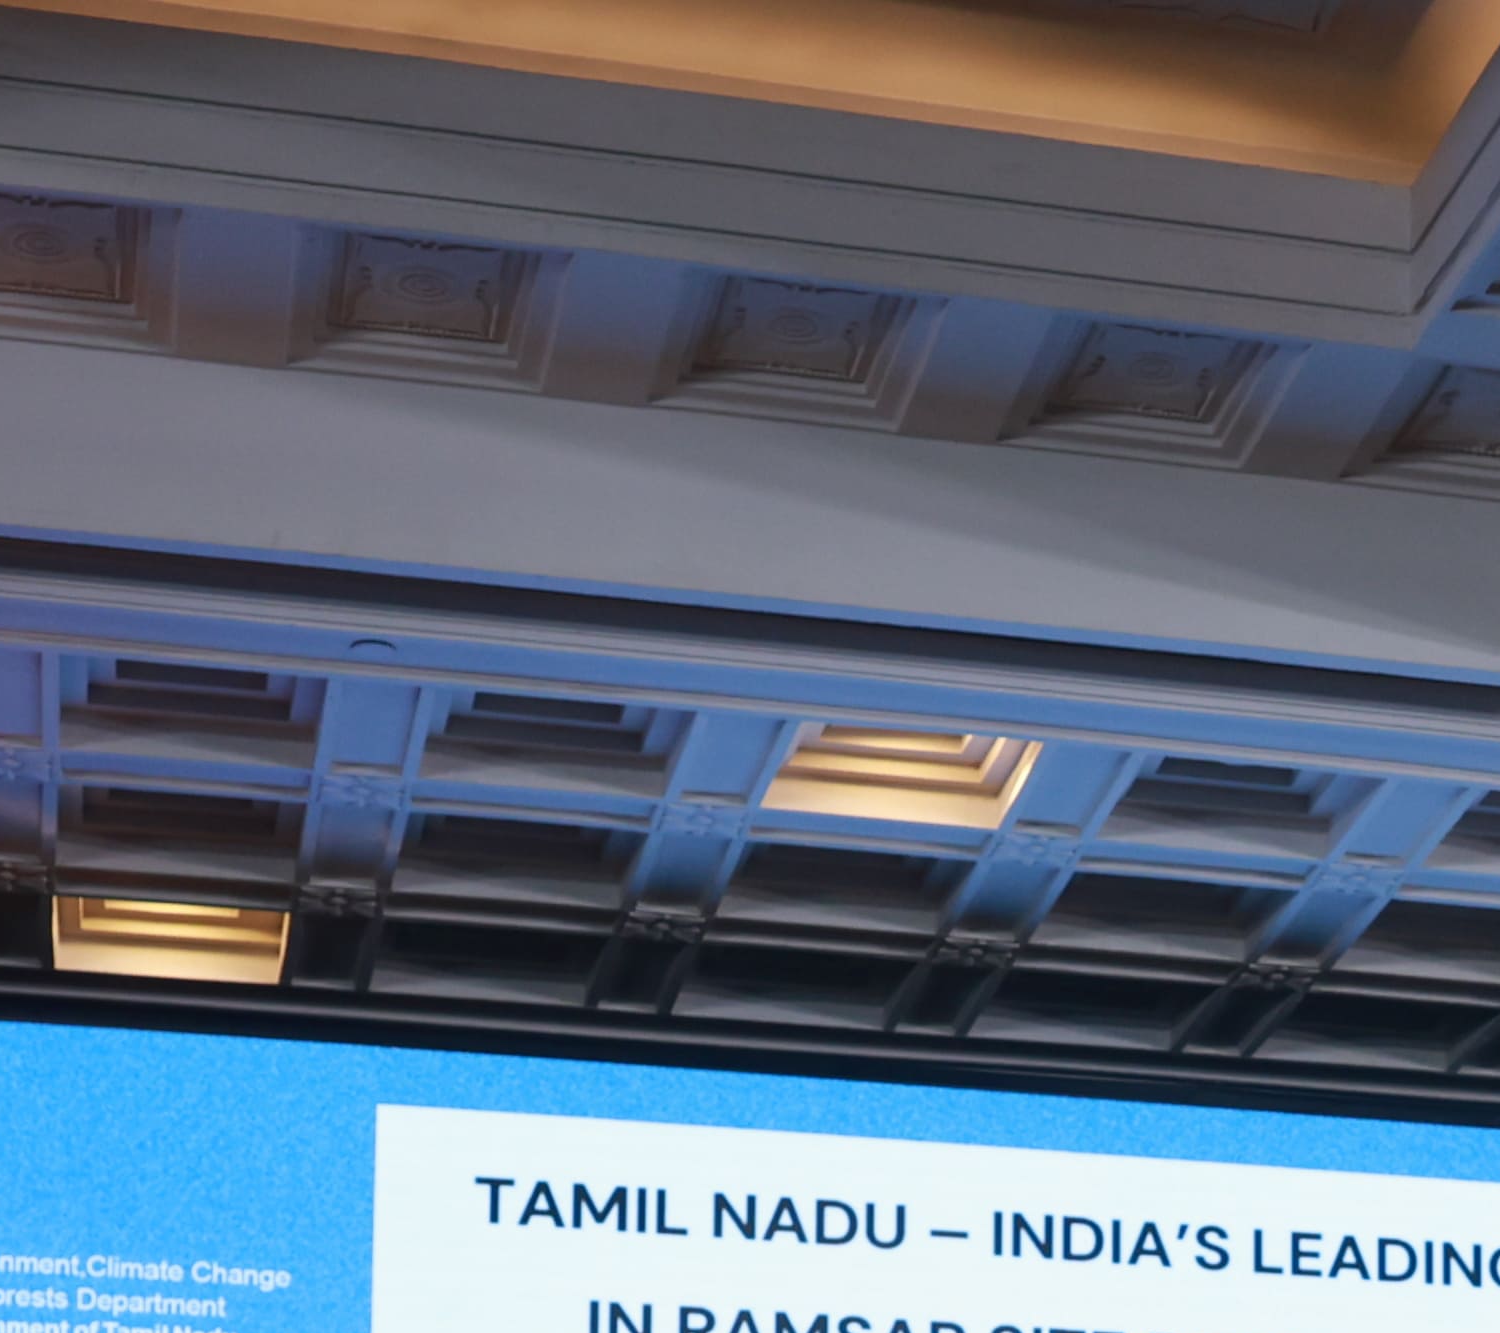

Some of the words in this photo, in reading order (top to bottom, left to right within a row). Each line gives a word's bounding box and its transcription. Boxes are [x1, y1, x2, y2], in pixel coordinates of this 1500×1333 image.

[475, 1175, 689, 1237] TAMIL
[711, 1192, 907, 1251] NADU
[191, 1261, 292, 1292] Change
[77, 1287, 227, 1319] Department
